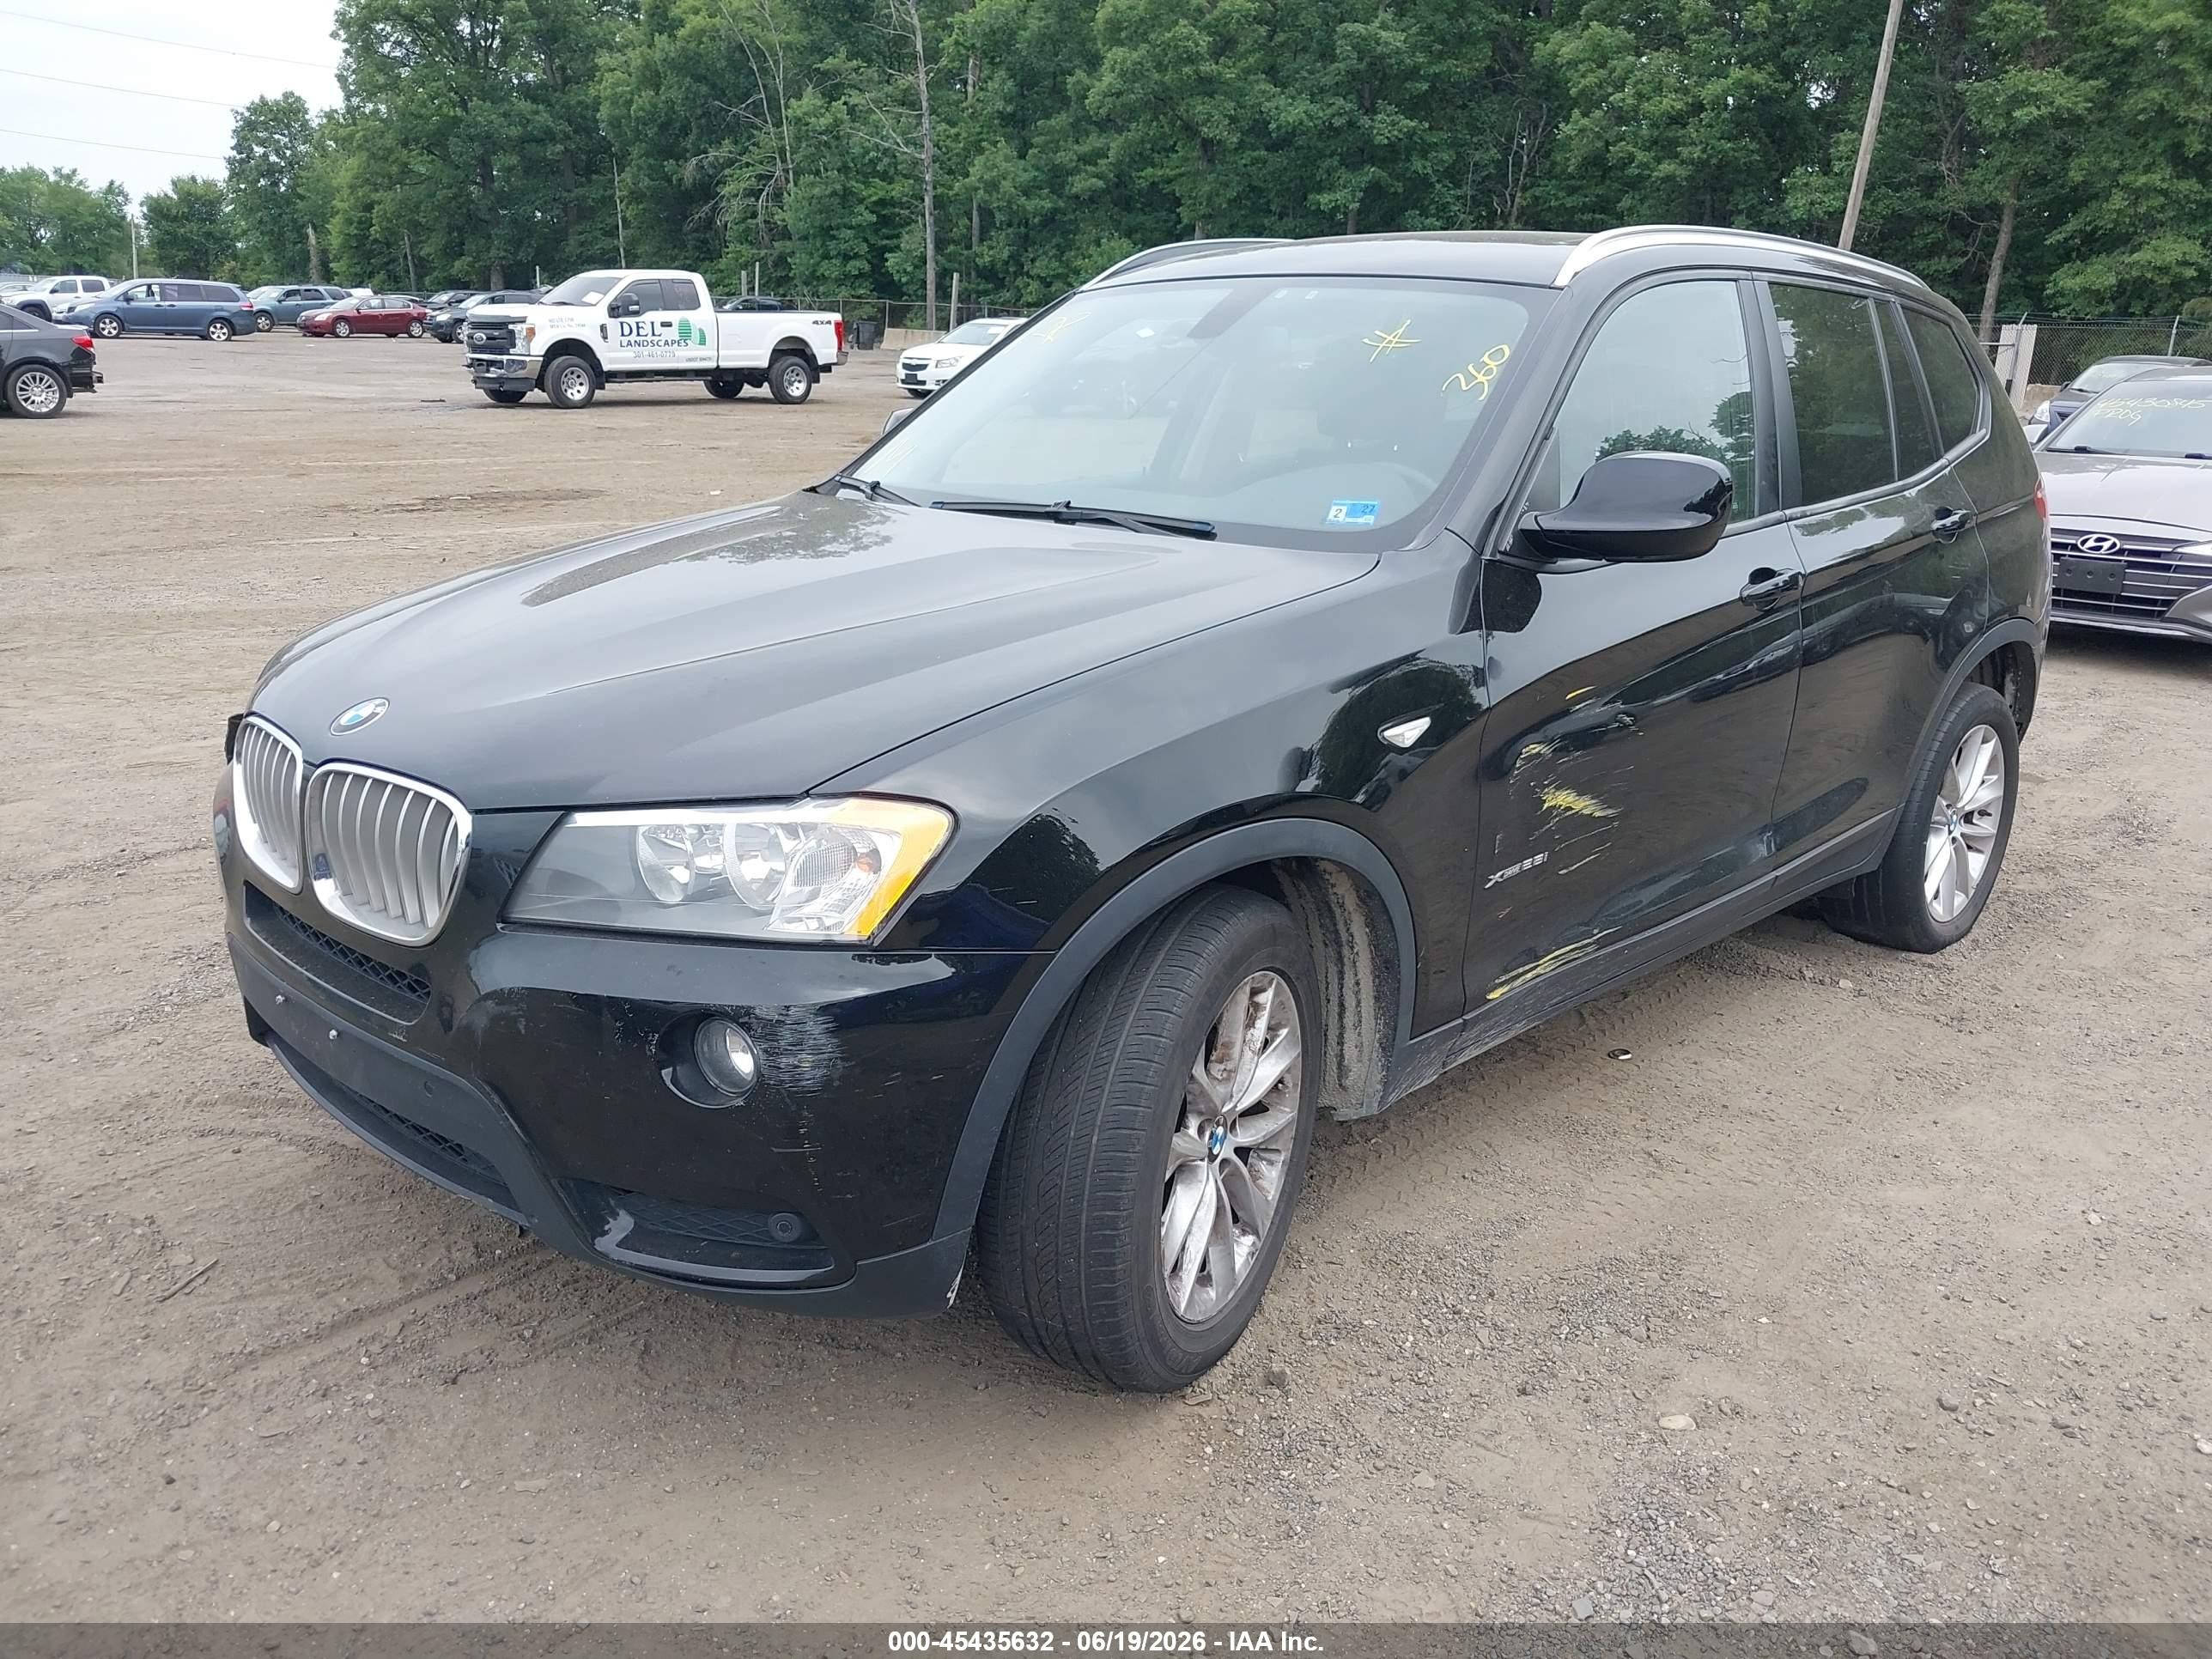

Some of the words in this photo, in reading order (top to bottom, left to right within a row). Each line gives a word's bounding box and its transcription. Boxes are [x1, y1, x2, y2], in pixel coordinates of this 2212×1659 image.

[619, 321, 663, 337] DEL
[619, 339, 690, 348] LANDSCAPES
[1442, 344, 1510, 401] 360
[1334, 507, 1343, 519] 2
[1361, 503, 1376, 514] 27
